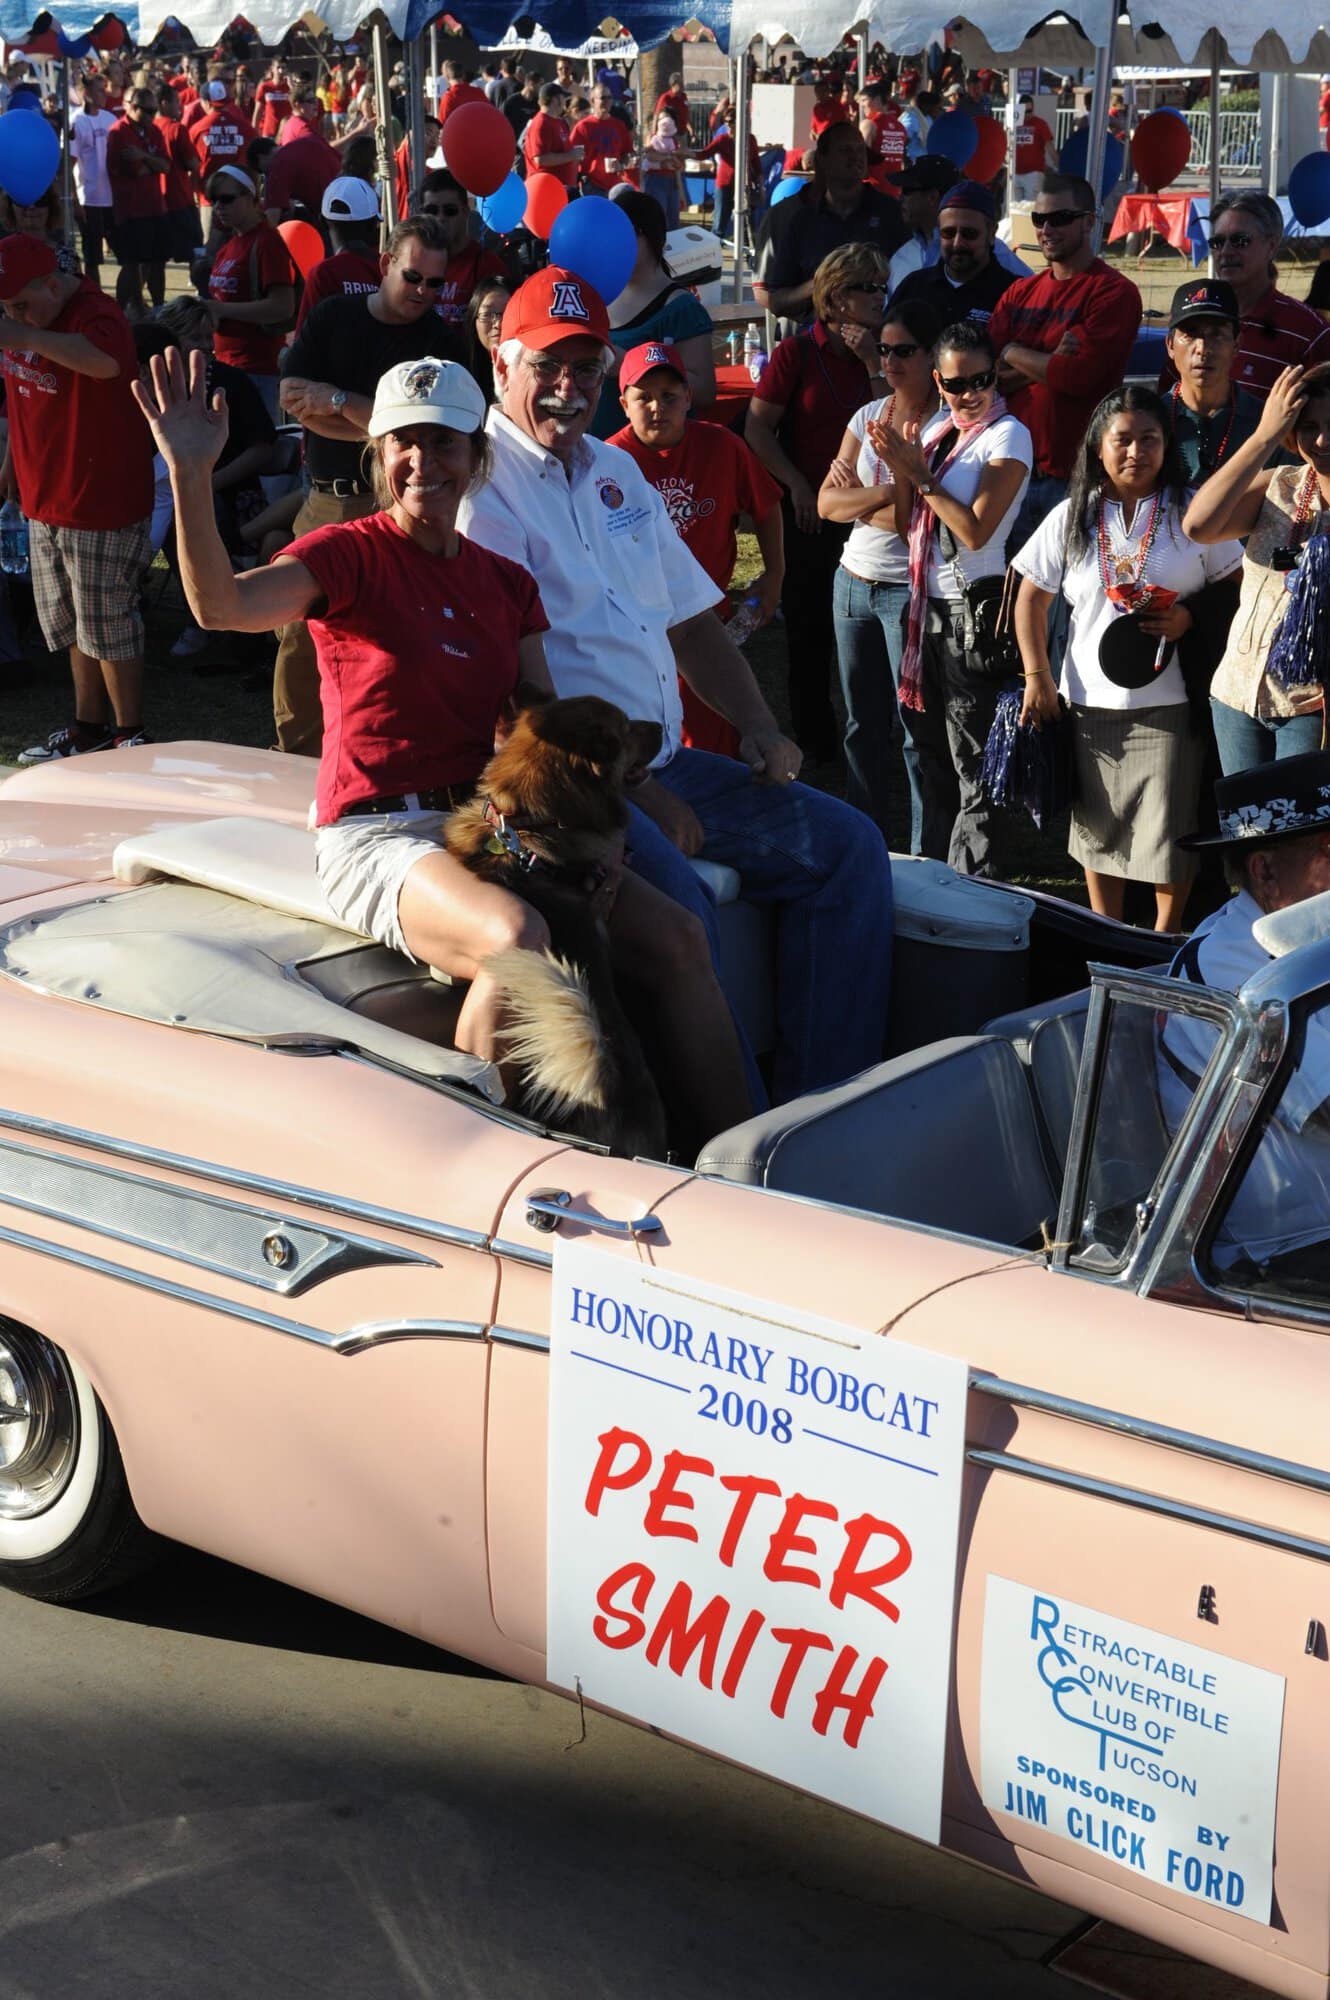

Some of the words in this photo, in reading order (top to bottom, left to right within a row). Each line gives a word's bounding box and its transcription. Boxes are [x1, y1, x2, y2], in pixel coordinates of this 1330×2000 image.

[549, 281, 590, 321] A
[569, 1286, 774, 1385] HONORARY
[784, 1355, 940, 1439] BOBCAT
[697, 1383, 794, 1445] 2008
[584, 1425, 913, 1624] PETER
[592, 1562, 889, 1749] SMITH
[1030, 1594, 1218, 1696] RETRACTABLE
[1037, 1645, 1230, 1736] CONVERTIBLE
[1097, 1728, 1198, 1798] TUCSON
[1145, 1719, 1176, 1745] OF
[1003, 1780, 1048, 1826] JIM
[1066, 1806, 1146, 1871] CLICK
[1166, 1848, 1245, 1907] FORD
[1016, 1754, 1156, 1824] SPONSORED
[1196, 1825, 1230, 1853] BY
